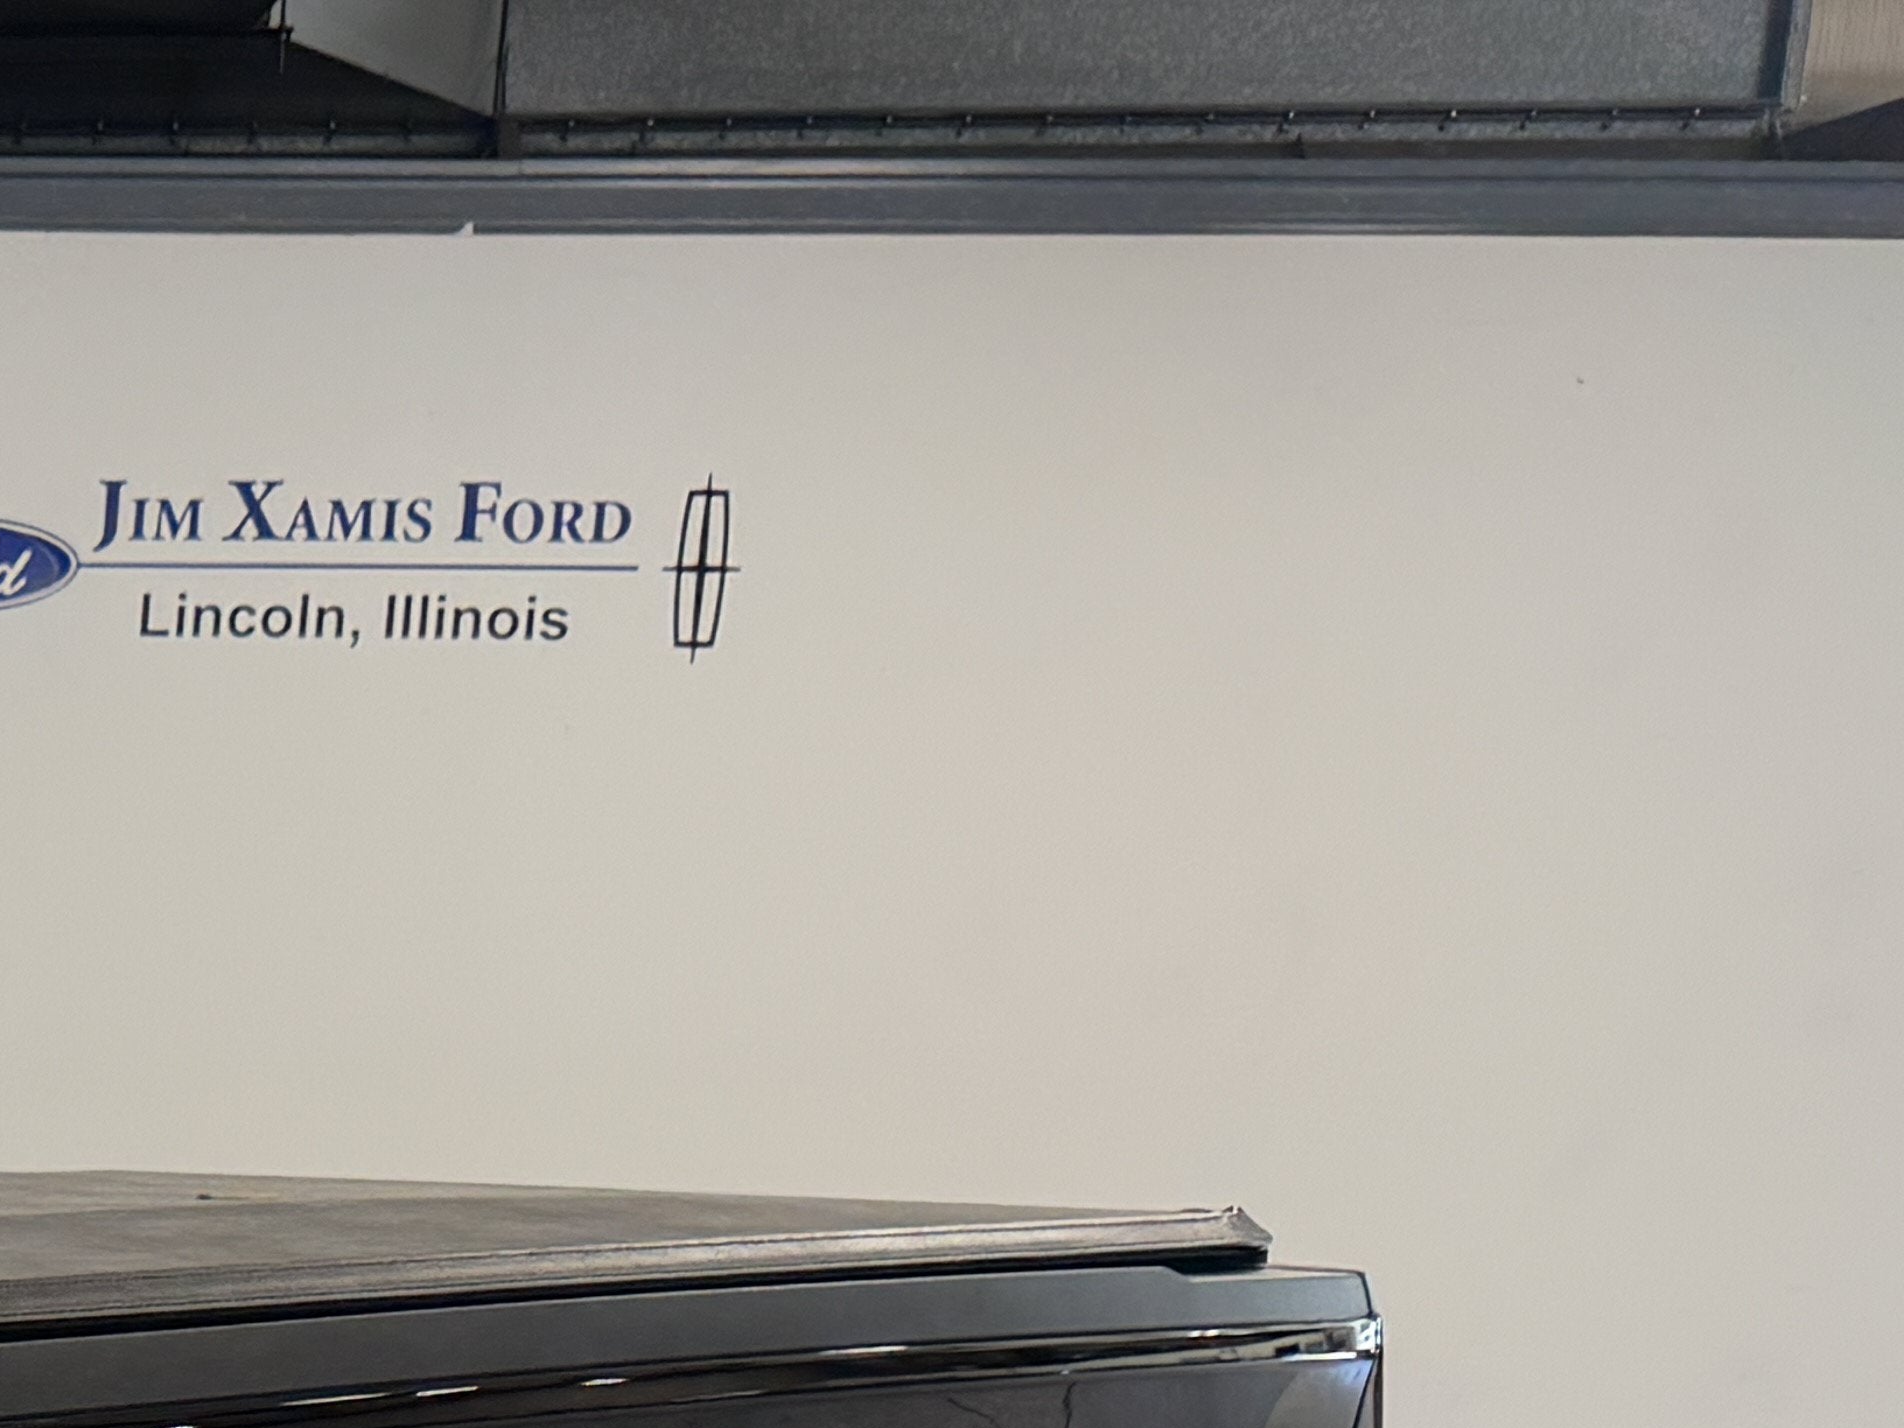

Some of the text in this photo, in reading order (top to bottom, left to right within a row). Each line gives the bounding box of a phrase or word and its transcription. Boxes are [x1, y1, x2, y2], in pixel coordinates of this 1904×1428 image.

[93, 479, 632, 552] JIM XAMIS FORD
[139, 592, 570, 649] Lincoln, Illinois
